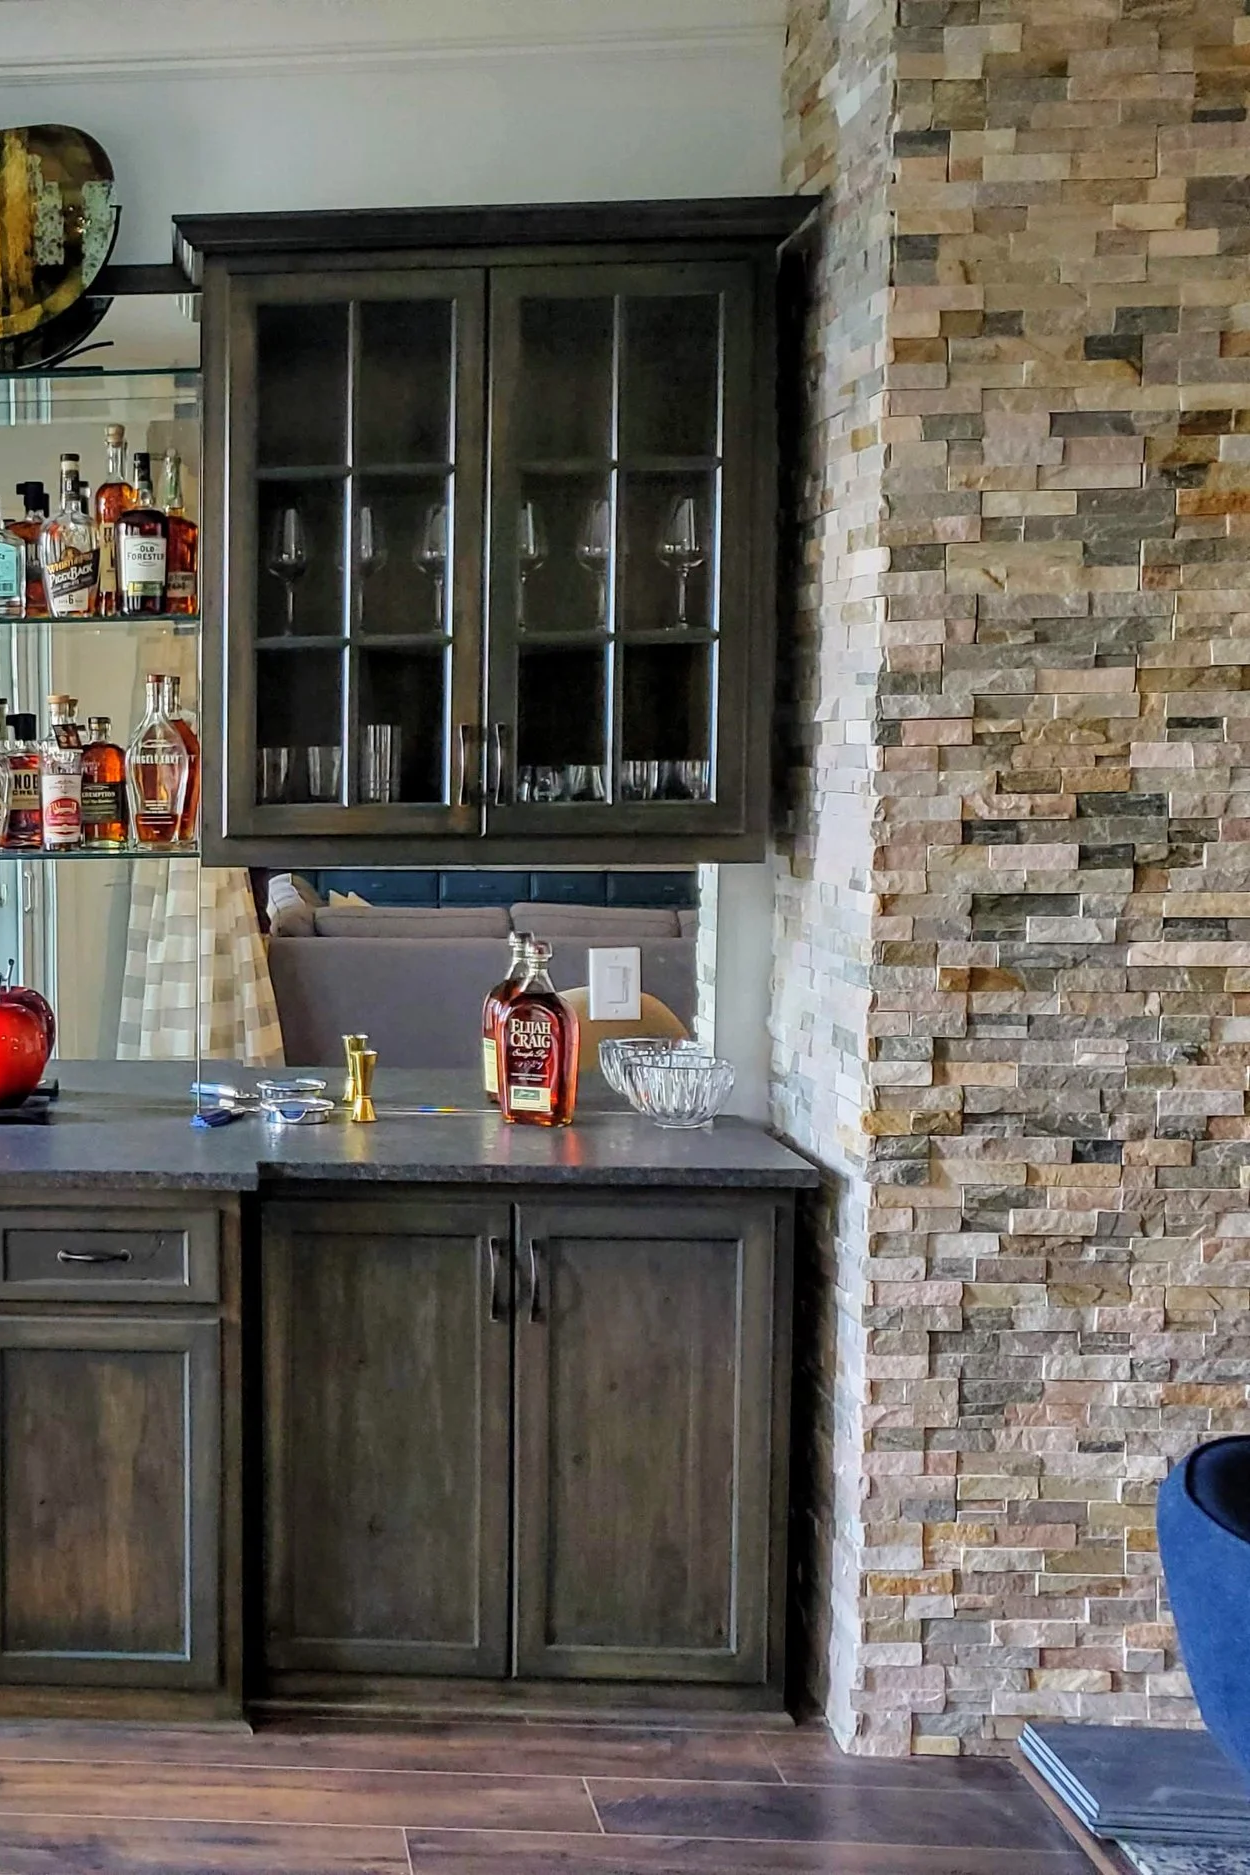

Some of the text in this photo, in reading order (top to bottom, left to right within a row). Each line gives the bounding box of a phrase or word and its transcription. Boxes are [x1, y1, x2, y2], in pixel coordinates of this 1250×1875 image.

[140, 545, 155, 553] OLD
[128, 553, 164, 561] FORESTER
[68, 594, 74, 604] 6
[14, 774, 38, 790] NOB
[510, 1018, 552, 1035] ELIJAH
[510, 1033, 551, 1049] CRAIG
